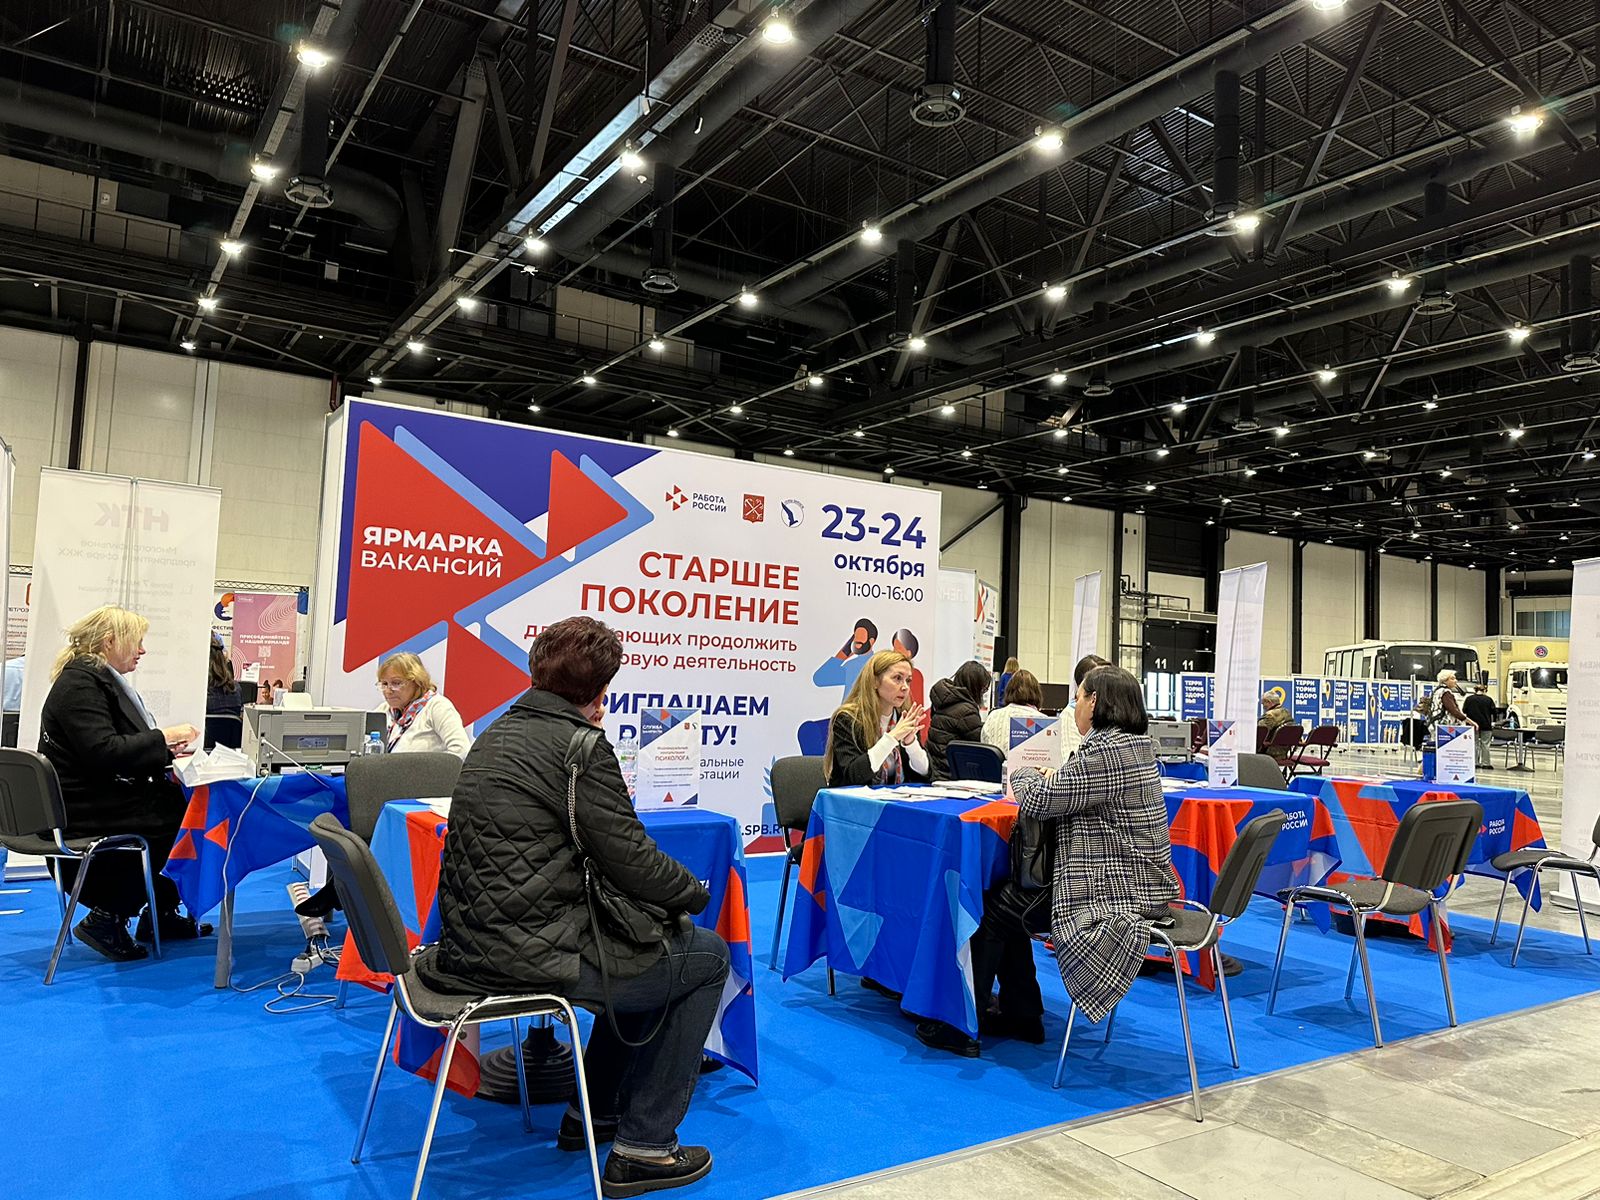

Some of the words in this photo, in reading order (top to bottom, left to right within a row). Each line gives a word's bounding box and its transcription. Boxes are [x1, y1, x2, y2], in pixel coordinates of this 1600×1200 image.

[692, 493, 725, 504] РАБОТА
[692, 502, 727, 513] РОССИИ
[821, 504, 927, 549] 23-24
[363, 526, 503, 556] ЯРМАРКА
[361, 550, 502, 578] ВАКАНСИЙ
[639, 551, 800, 590] СТАРШЕЕ
[834, 554, 925, 580] октября
[846, 581, 924, 602] 11:00-16:00
[580, 584, 799, 625] ПОКОЛЕНИЕ
[615, 630, 682, 647] ающих
[687, 632, 797, 652] продолжить
[620, 653, 669, 670] овую
[673, 656, 796, 672] деятельность
[1155, 658, 1167, 669] 11
[1182, 659, 1194, 671] 11
[1281, 819, 1309, 831] РОССИИ
